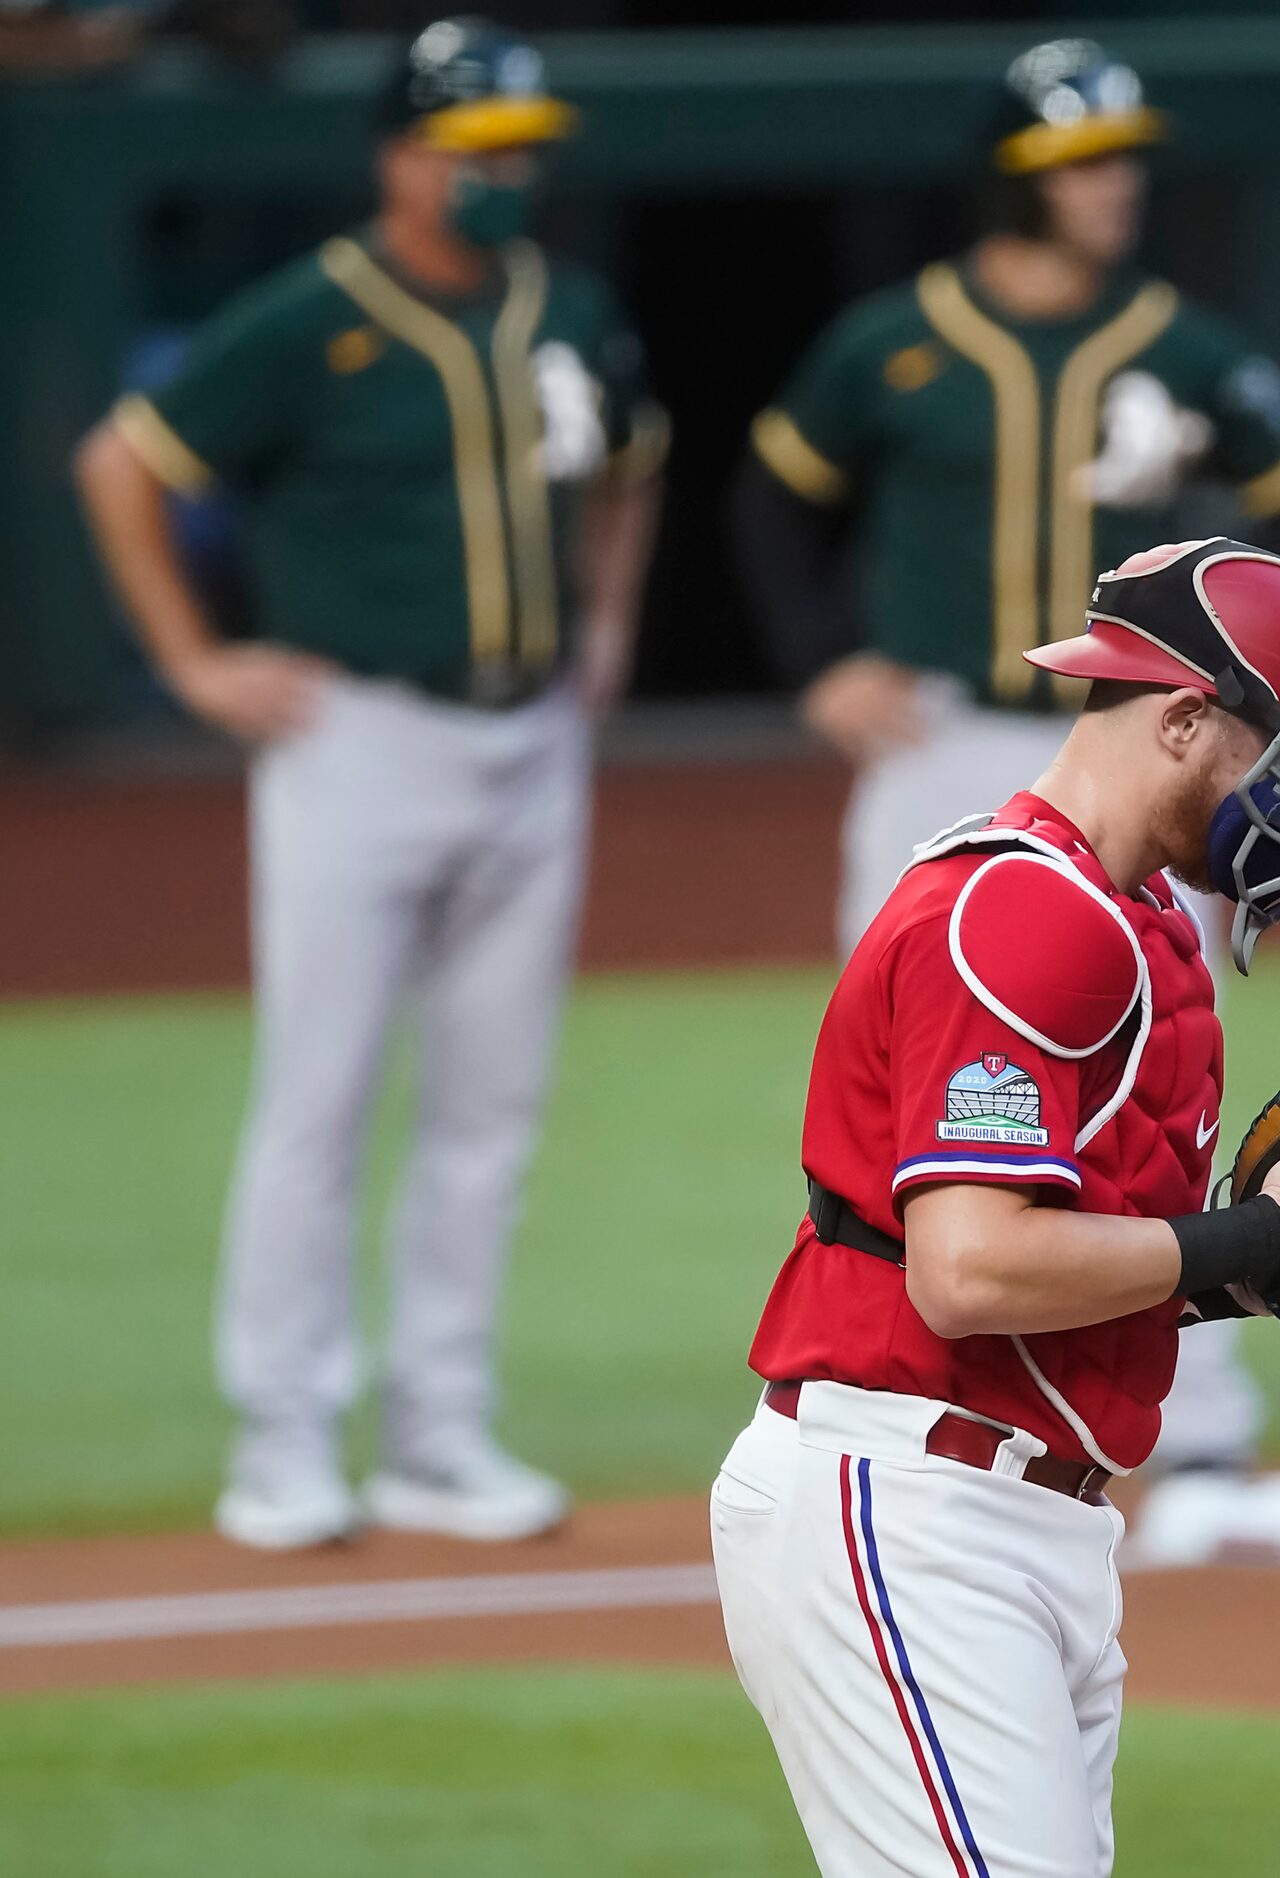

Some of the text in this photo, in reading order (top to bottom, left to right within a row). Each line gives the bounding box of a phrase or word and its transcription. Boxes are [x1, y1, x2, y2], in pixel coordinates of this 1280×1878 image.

[988, 1056, 1000, 1071] T
[958, 1075, 987, 1084] 2020
[944, 1126, 1043, 1143] INAUGURAL SEASON
